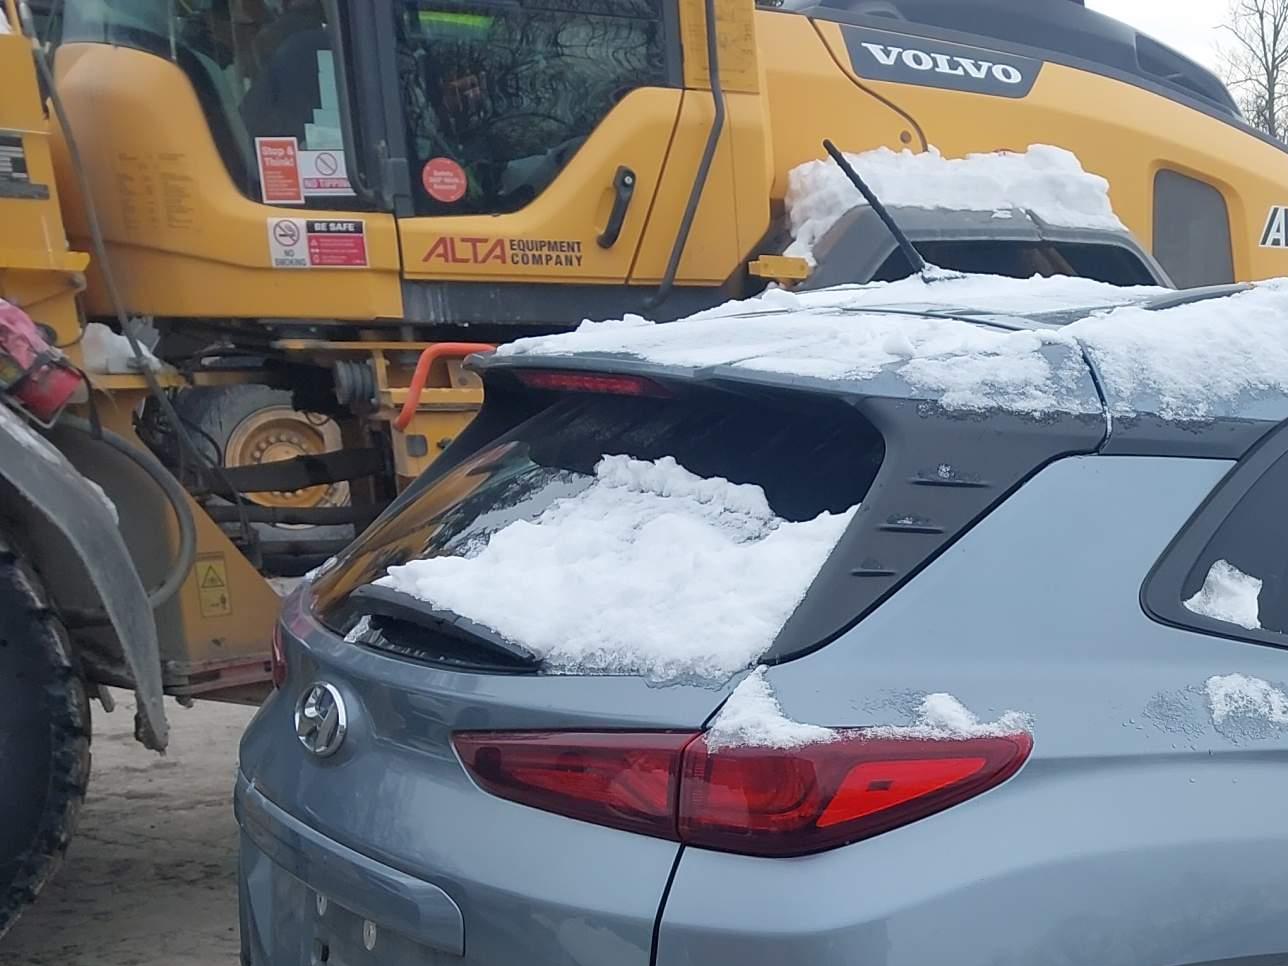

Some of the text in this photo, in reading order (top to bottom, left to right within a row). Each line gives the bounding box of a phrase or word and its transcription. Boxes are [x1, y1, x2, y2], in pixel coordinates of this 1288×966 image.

[861, 42, 1022, 84] VOLVO
[314, 222, 355, 232] BE SAFE
[422, 236, 507, 265] ALTA
[509, 239, 582, 253] EQUIPMENT
[511, 253, 582, 267] COMPANY
